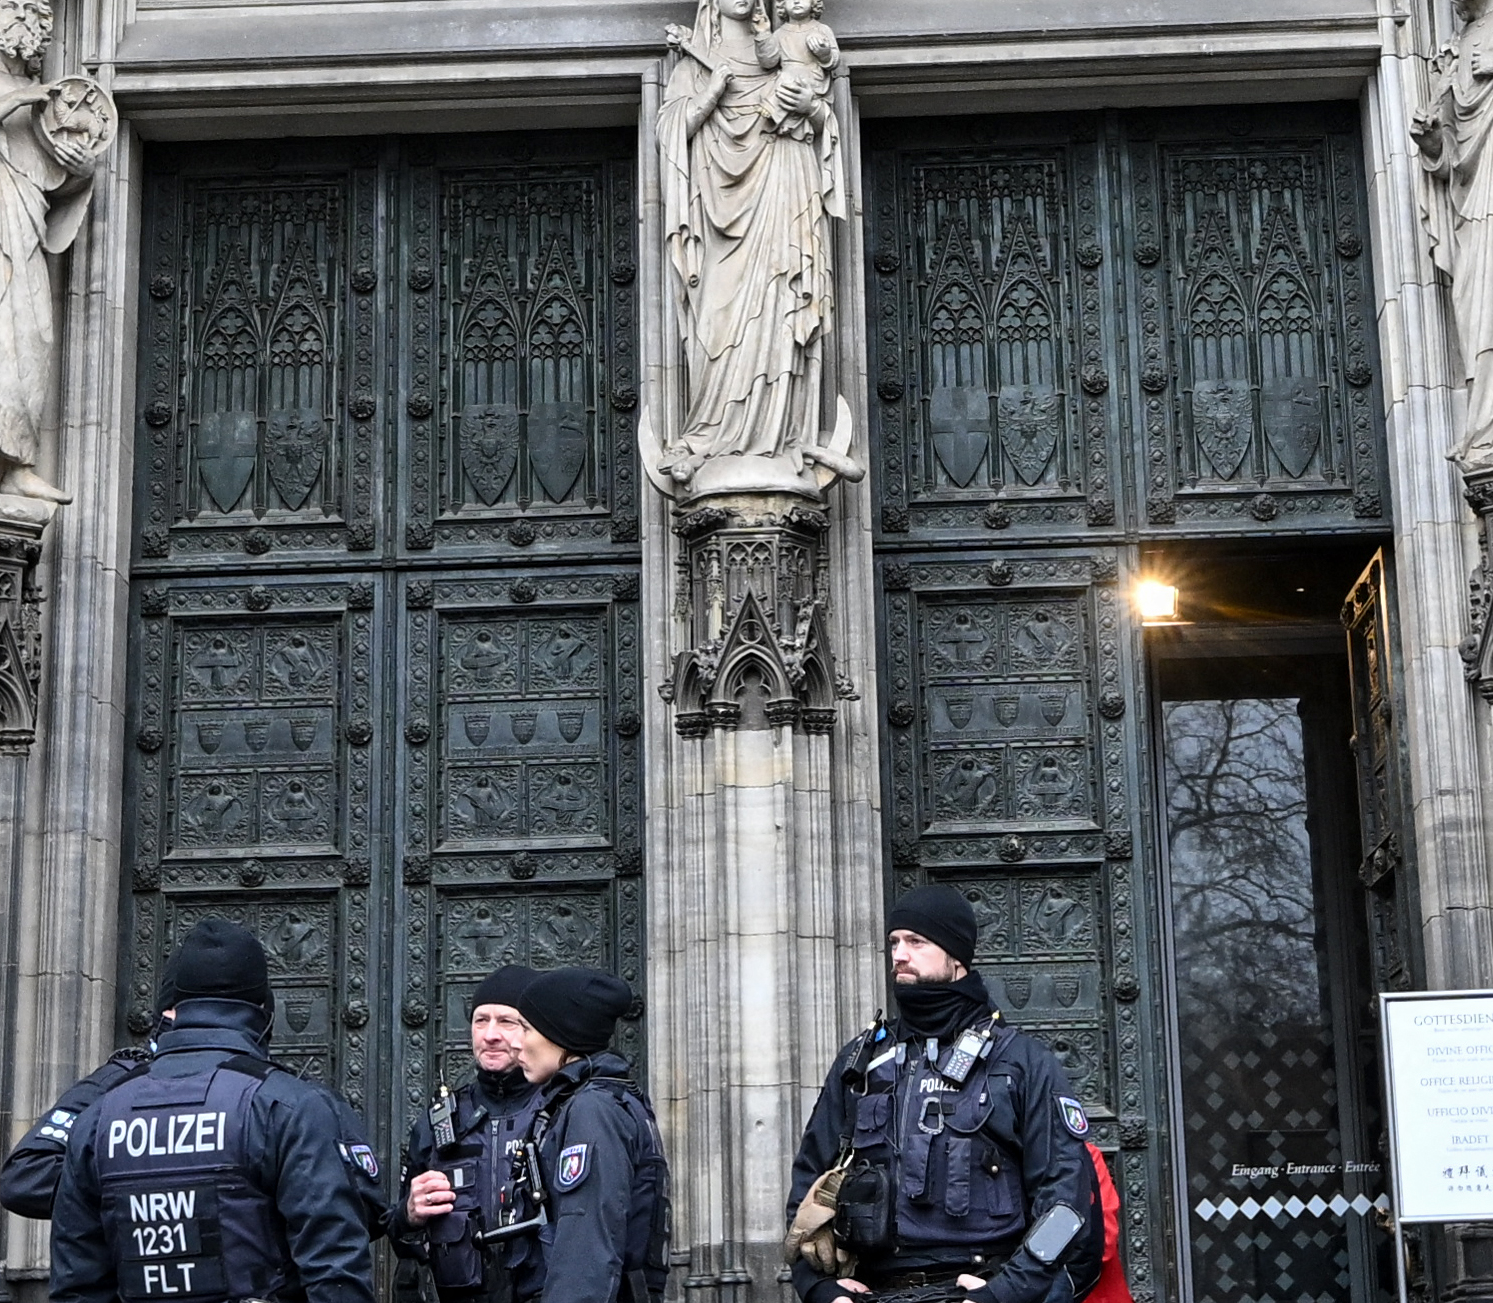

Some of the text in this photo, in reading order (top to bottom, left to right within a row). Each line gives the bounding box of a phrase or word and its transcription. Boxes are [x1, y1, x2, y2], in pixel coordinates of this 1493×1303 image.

[1426, 1046, 1463, 1057] DIVINE
[1420, 1077, 1455, 1087] OFFICE
[1427, 1107, 1468, 1117] UFFICIO
[108, 1111, 227, 1159] POLIZEI
[1231, 1160, 1381, 1179] Eingang Entrance Entrée
[129, 1190, 196, 1222] NRW
[132, 1222, 188, 1256] 1231
[143, 1262, 196, 1294] FLT
